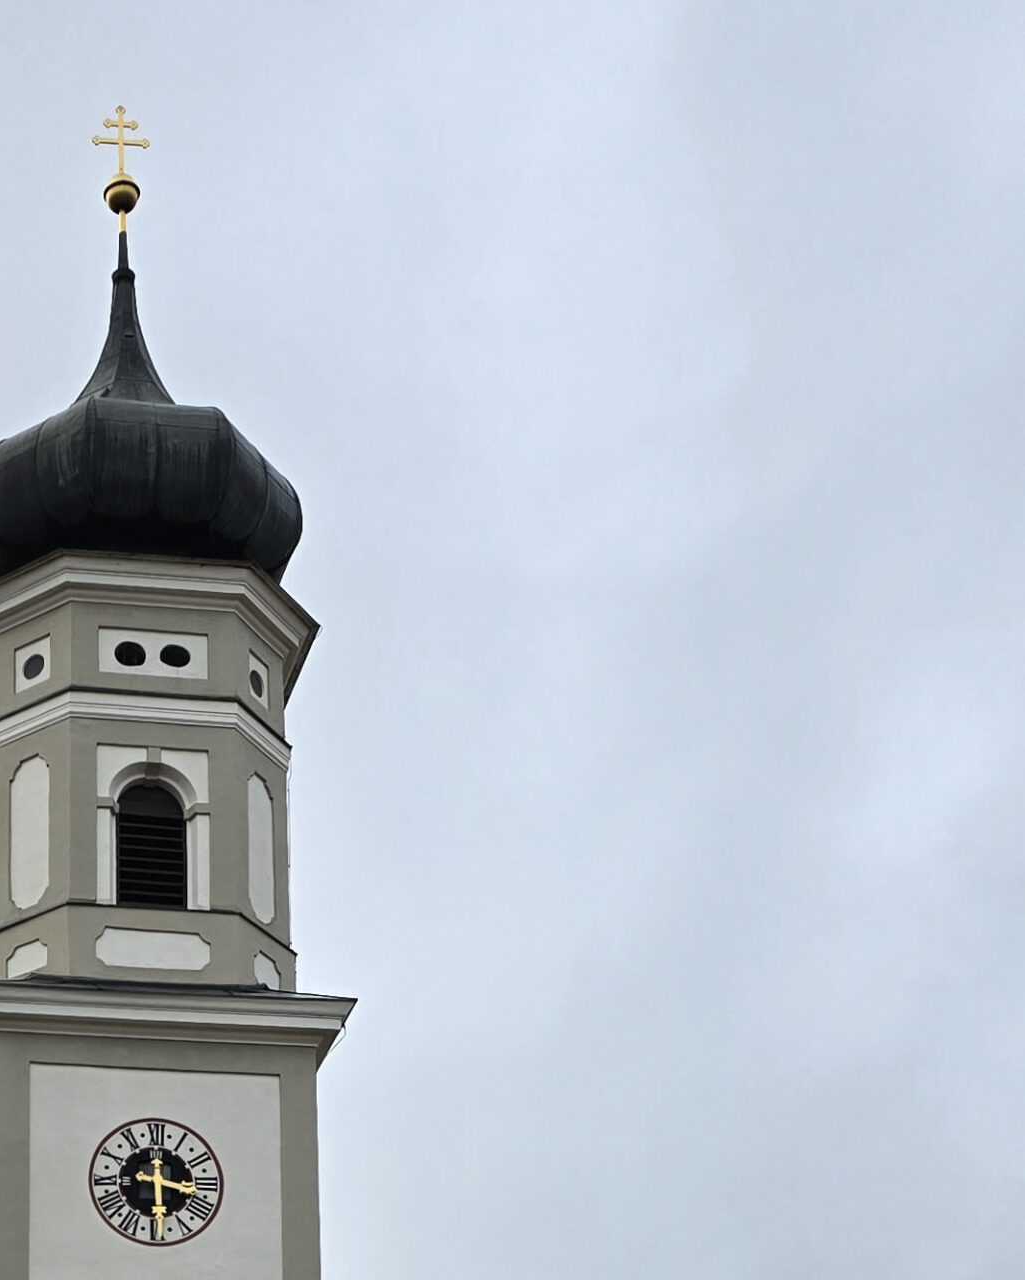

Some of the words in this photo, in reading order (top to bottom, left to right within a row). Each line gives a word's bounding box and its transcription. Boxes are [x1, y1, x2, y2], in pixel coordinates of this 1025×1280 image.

[119, 1128, 140, 1151] XI
[147, 1123, 166, 1146] XII
[174, 1132, 188, 1152] I
[100, 1146, 124, 1166] X
[187, 1151, 211, 1169] II
[94, 1173, 117, 1186] IX
[195, 1177, 218, 1192] III
[97, 1190, 126, 1220] VIII
[185, 1195, 215, 1222] IIII
[117, 1209, 140, 1237] VII
[175, 1214, 193, 1236] V
